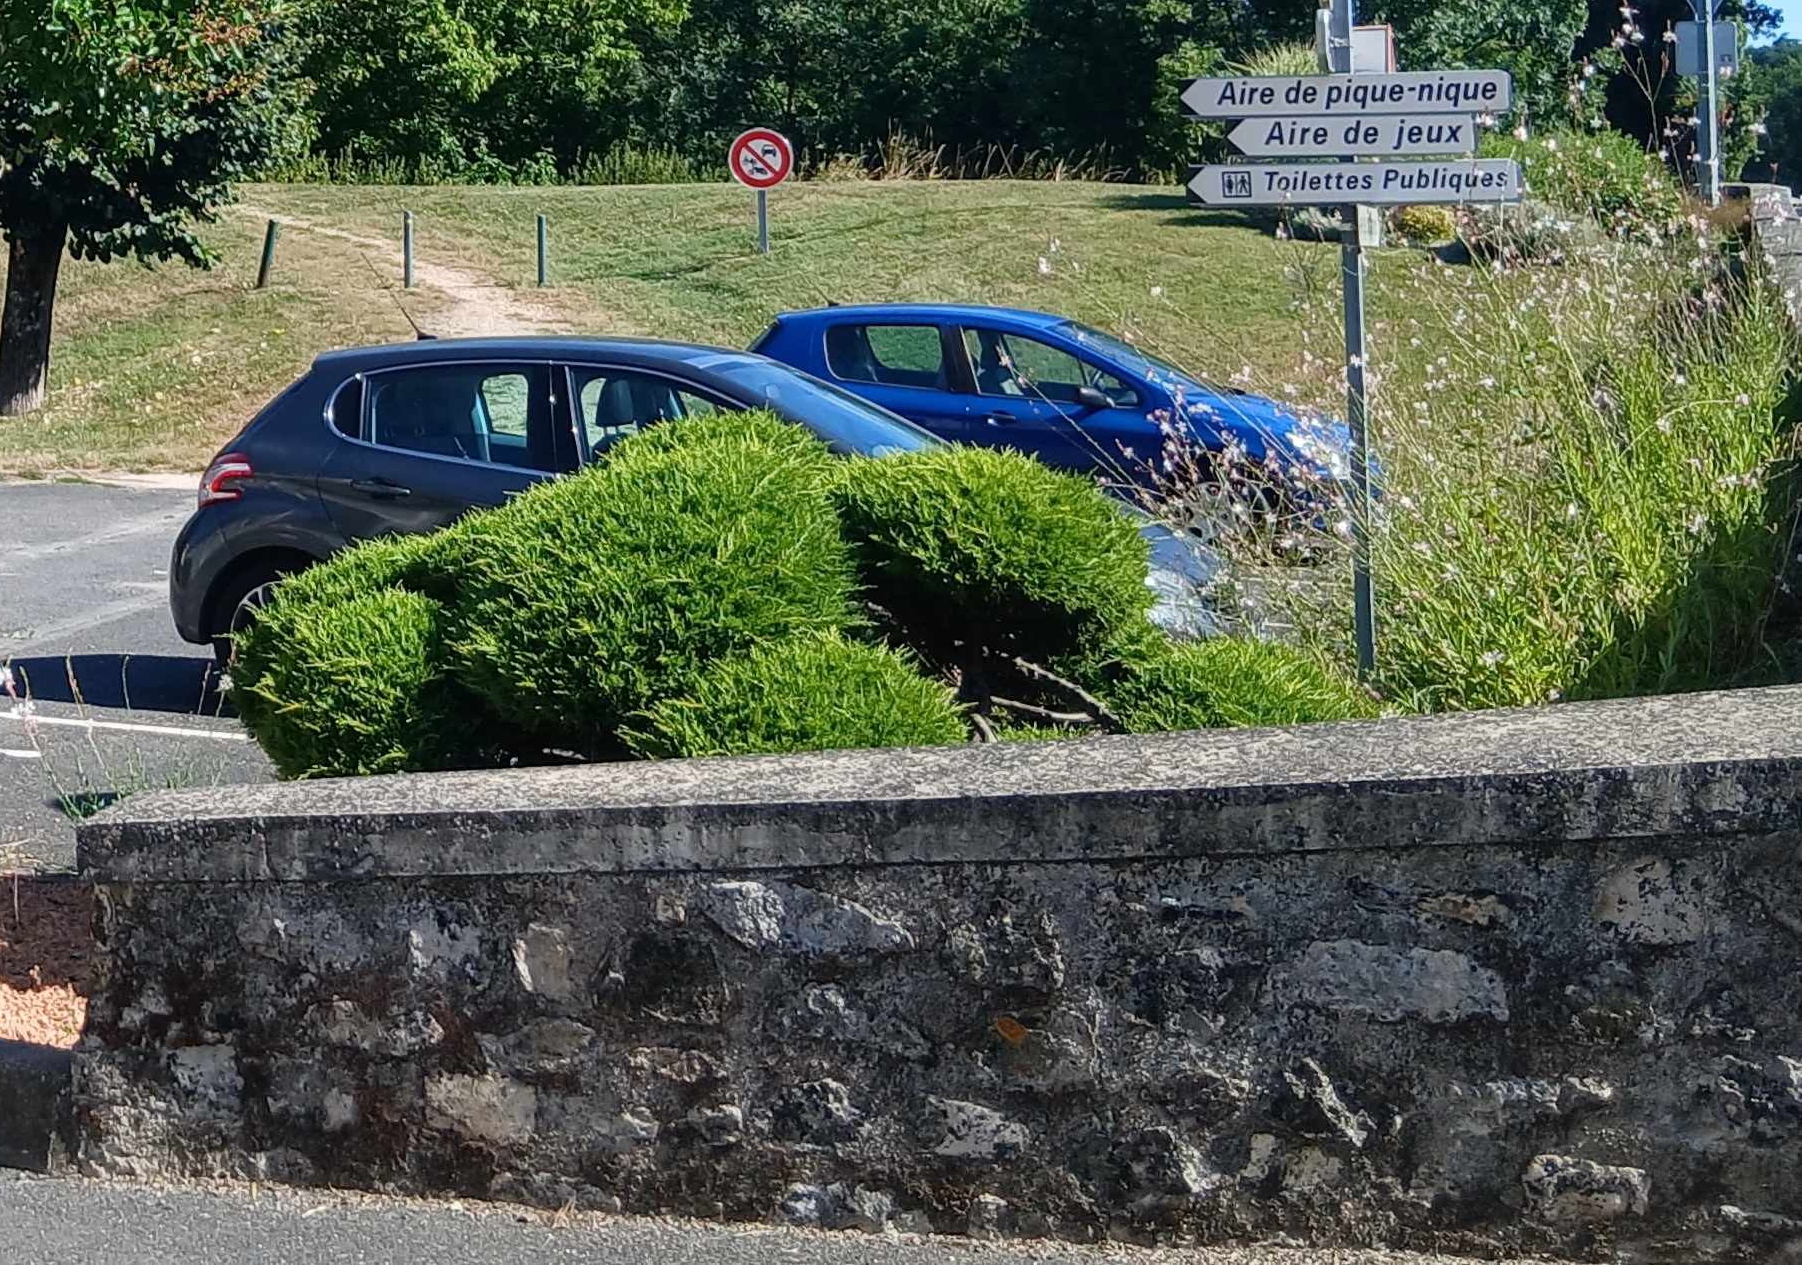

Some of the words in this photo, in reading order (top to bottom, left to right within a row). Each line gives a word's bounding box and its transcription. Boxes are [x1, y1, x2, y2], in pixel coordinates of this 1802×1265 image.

[1216, 80, 1275, 106] Aire
[1285, 79, 1318, 105] de
[1324, 75, 1498, 111] pique-nique
[1264, 120, 1329, 146] Aire
[1343, 119, 1379, 145] de
[1392, 120, 1463, 151] jeux
[1264, 168, 1374, 192] Toilettes
[1382, 167, 1509, 195] Publiques
